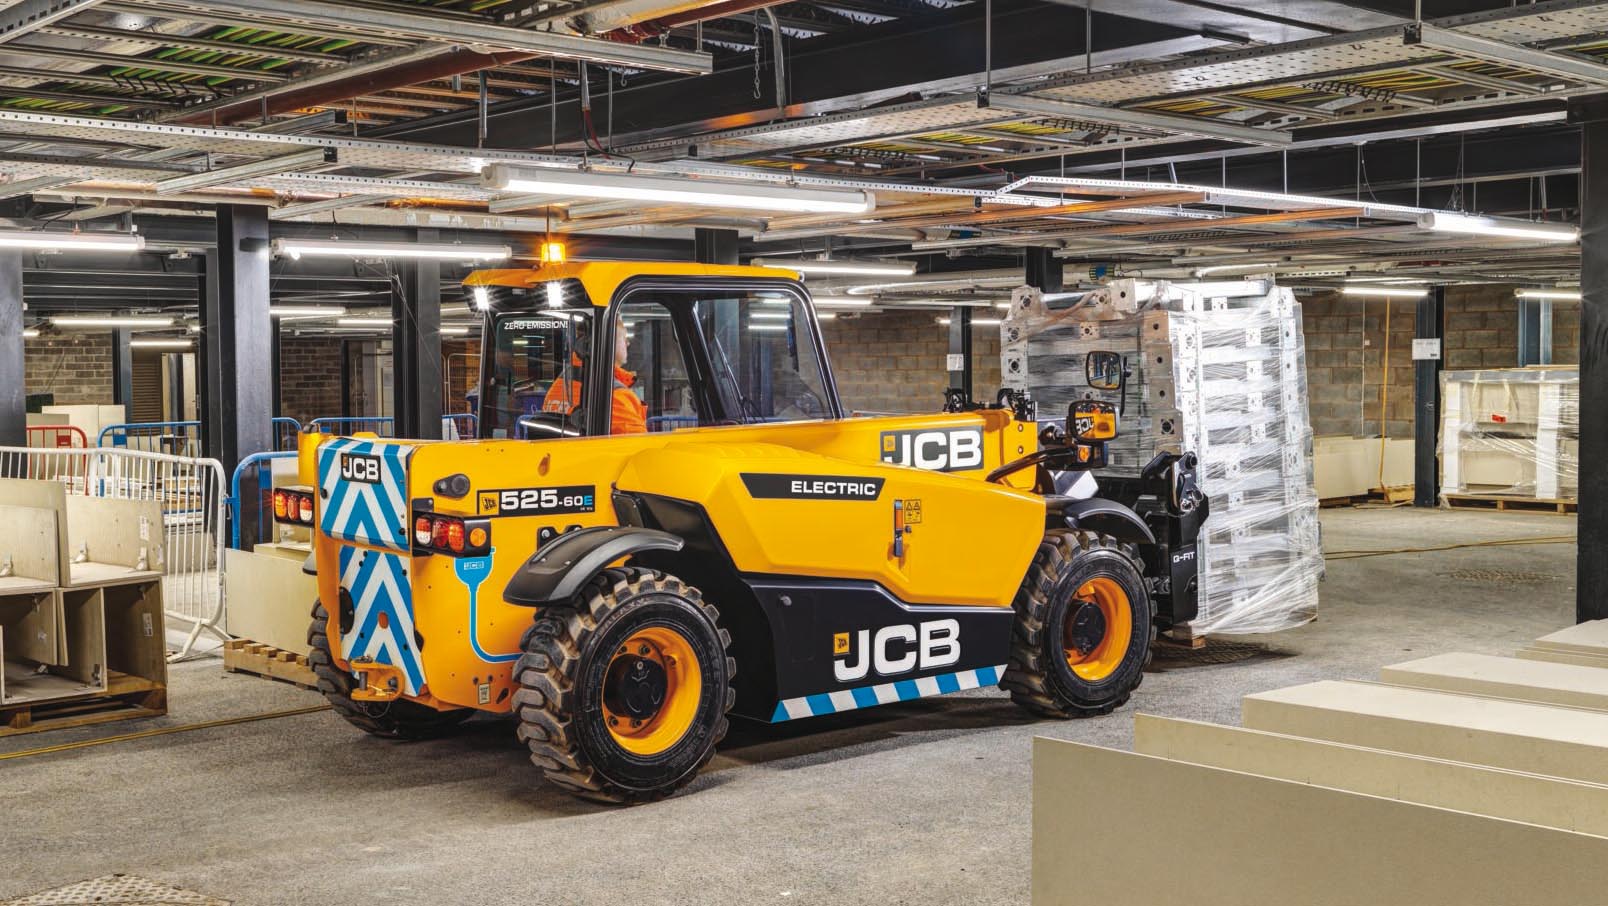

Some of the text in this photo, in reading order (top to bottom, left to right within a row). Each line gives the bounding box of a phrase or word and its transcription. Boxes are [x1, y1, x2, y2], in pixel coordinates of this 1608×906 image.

[504, 320, 568, 330] ZERO EMISSION!
[884, 430, 981, 470] JCB
[343, 457, 379, 480] JCB
[791, 481, 876, 495] ELECTRIC
[834, 618, 961, 682] JCB
